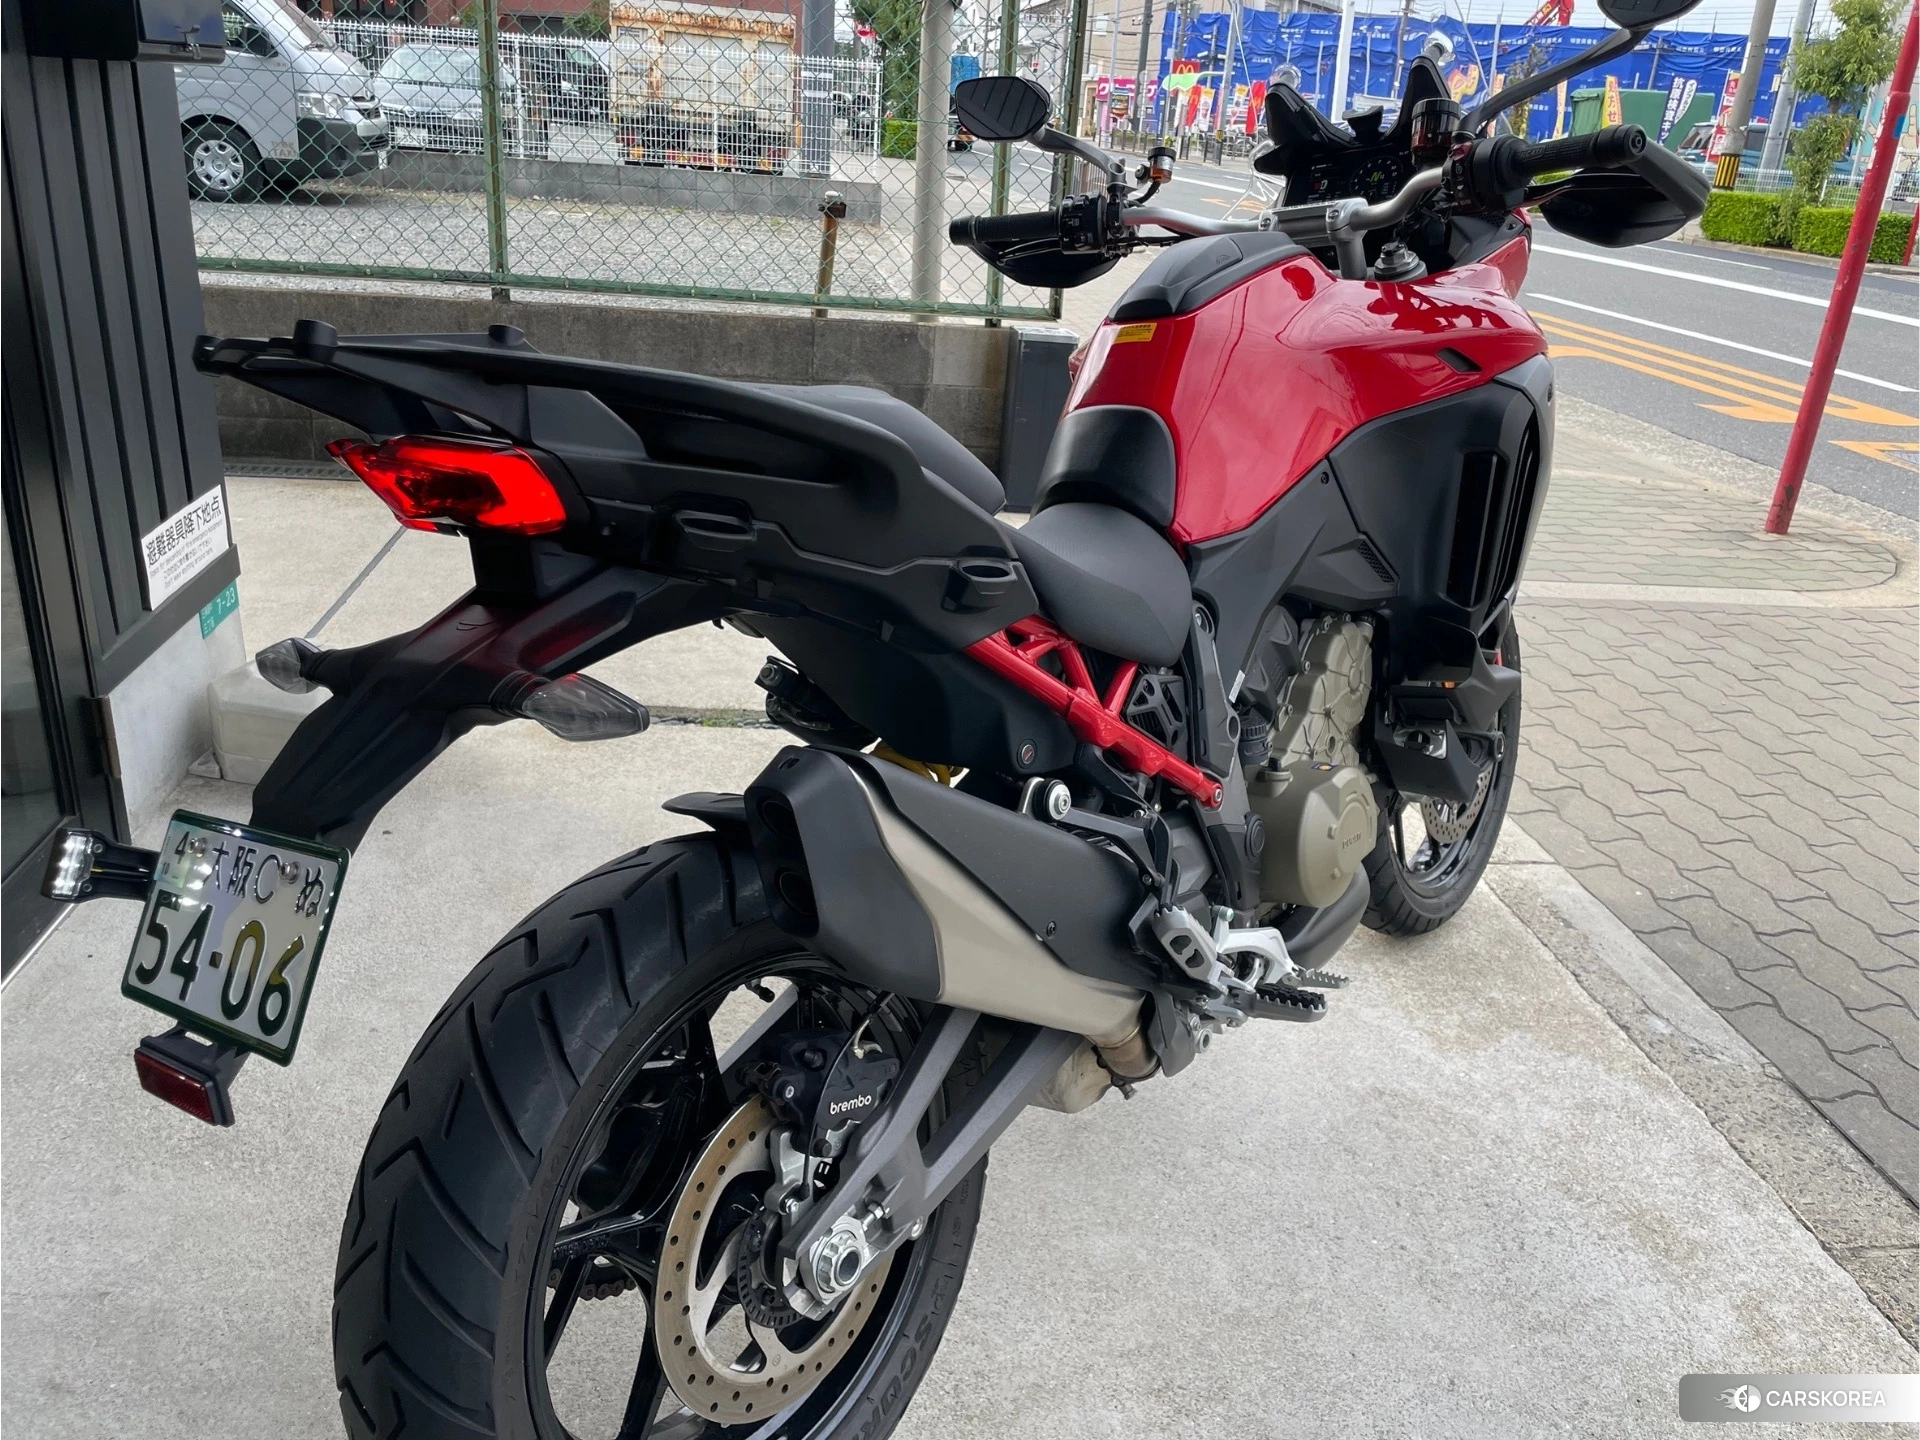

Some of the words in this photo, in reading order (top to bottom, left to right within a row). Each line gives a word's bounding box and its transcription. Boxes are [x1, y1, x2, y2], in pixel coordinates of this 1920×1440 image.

[145, 495, 222, 566] 避難器具降下地点
[216, 587, 236, 615] 7-23
[829, 1094, 872, 1115] brembo
[852, 1313, 934, 1440] SCOR
